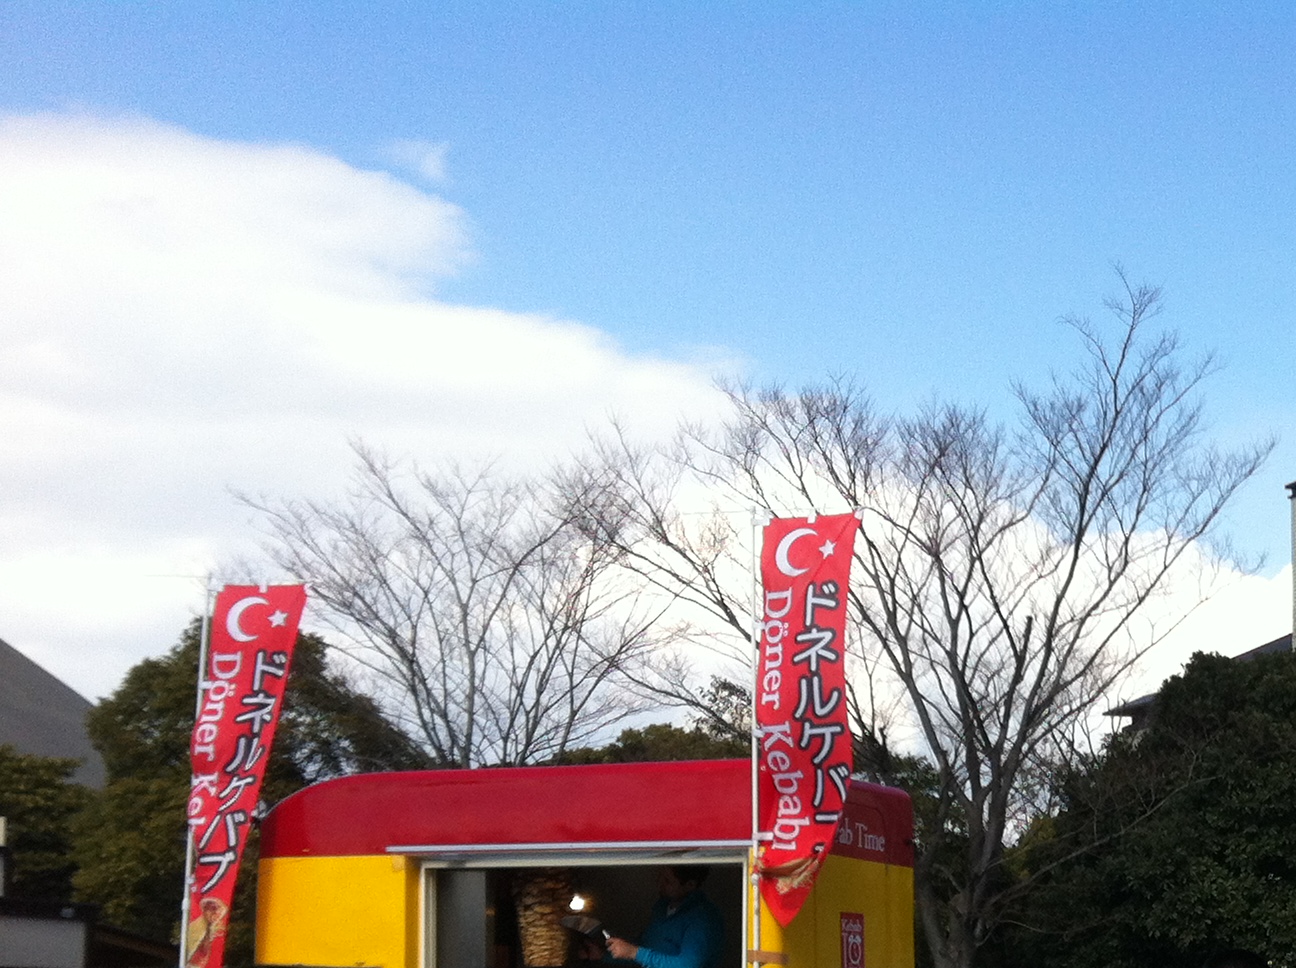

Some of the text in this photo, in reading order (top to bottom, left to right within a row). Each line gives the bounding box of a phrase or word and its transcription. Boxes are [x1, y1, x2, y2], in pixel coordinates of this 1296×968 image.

[761, 588, 792, 708] Döner
[199, 649, 288, 894] ドネルケバブ
